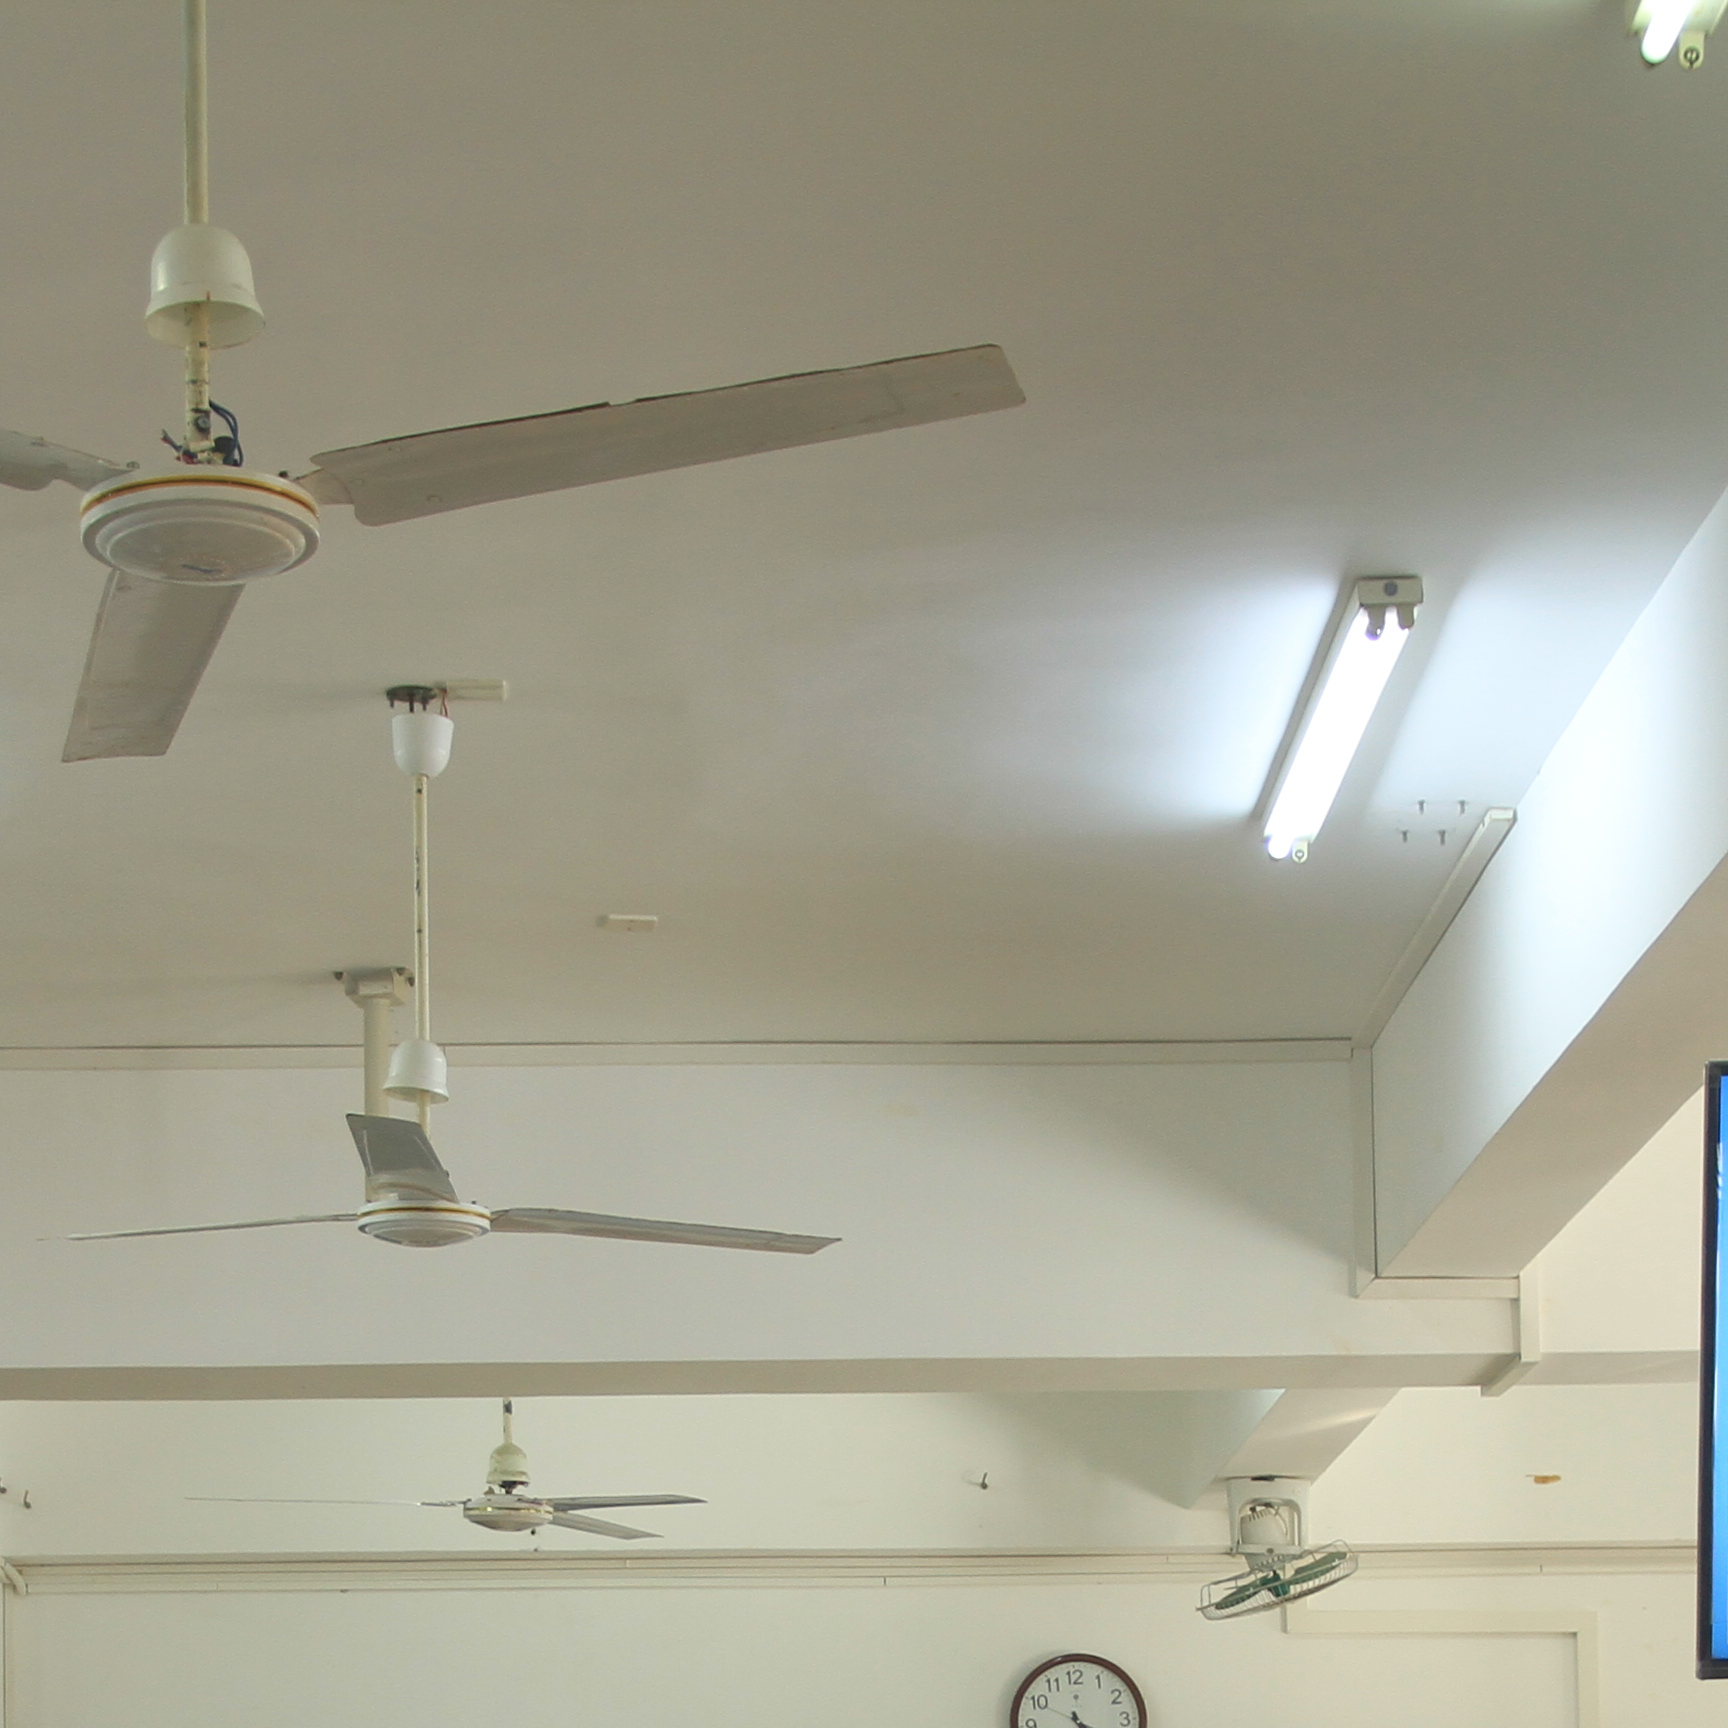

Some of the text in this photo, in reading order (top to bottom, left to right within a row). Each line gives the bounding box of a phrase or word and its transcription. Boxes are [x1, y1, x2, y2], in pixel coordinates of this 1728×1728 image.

[1045, 1677, 1061, 1693] 11
[1065, 1669, 1084, 1686] 12
[1095, 1674, 1102, 1690] 1
[1030, 1694, 1049, 1711] 10
[1110, 1688, 1123, 1705] 2
[1119, 1711, 1131, 1728] 3
